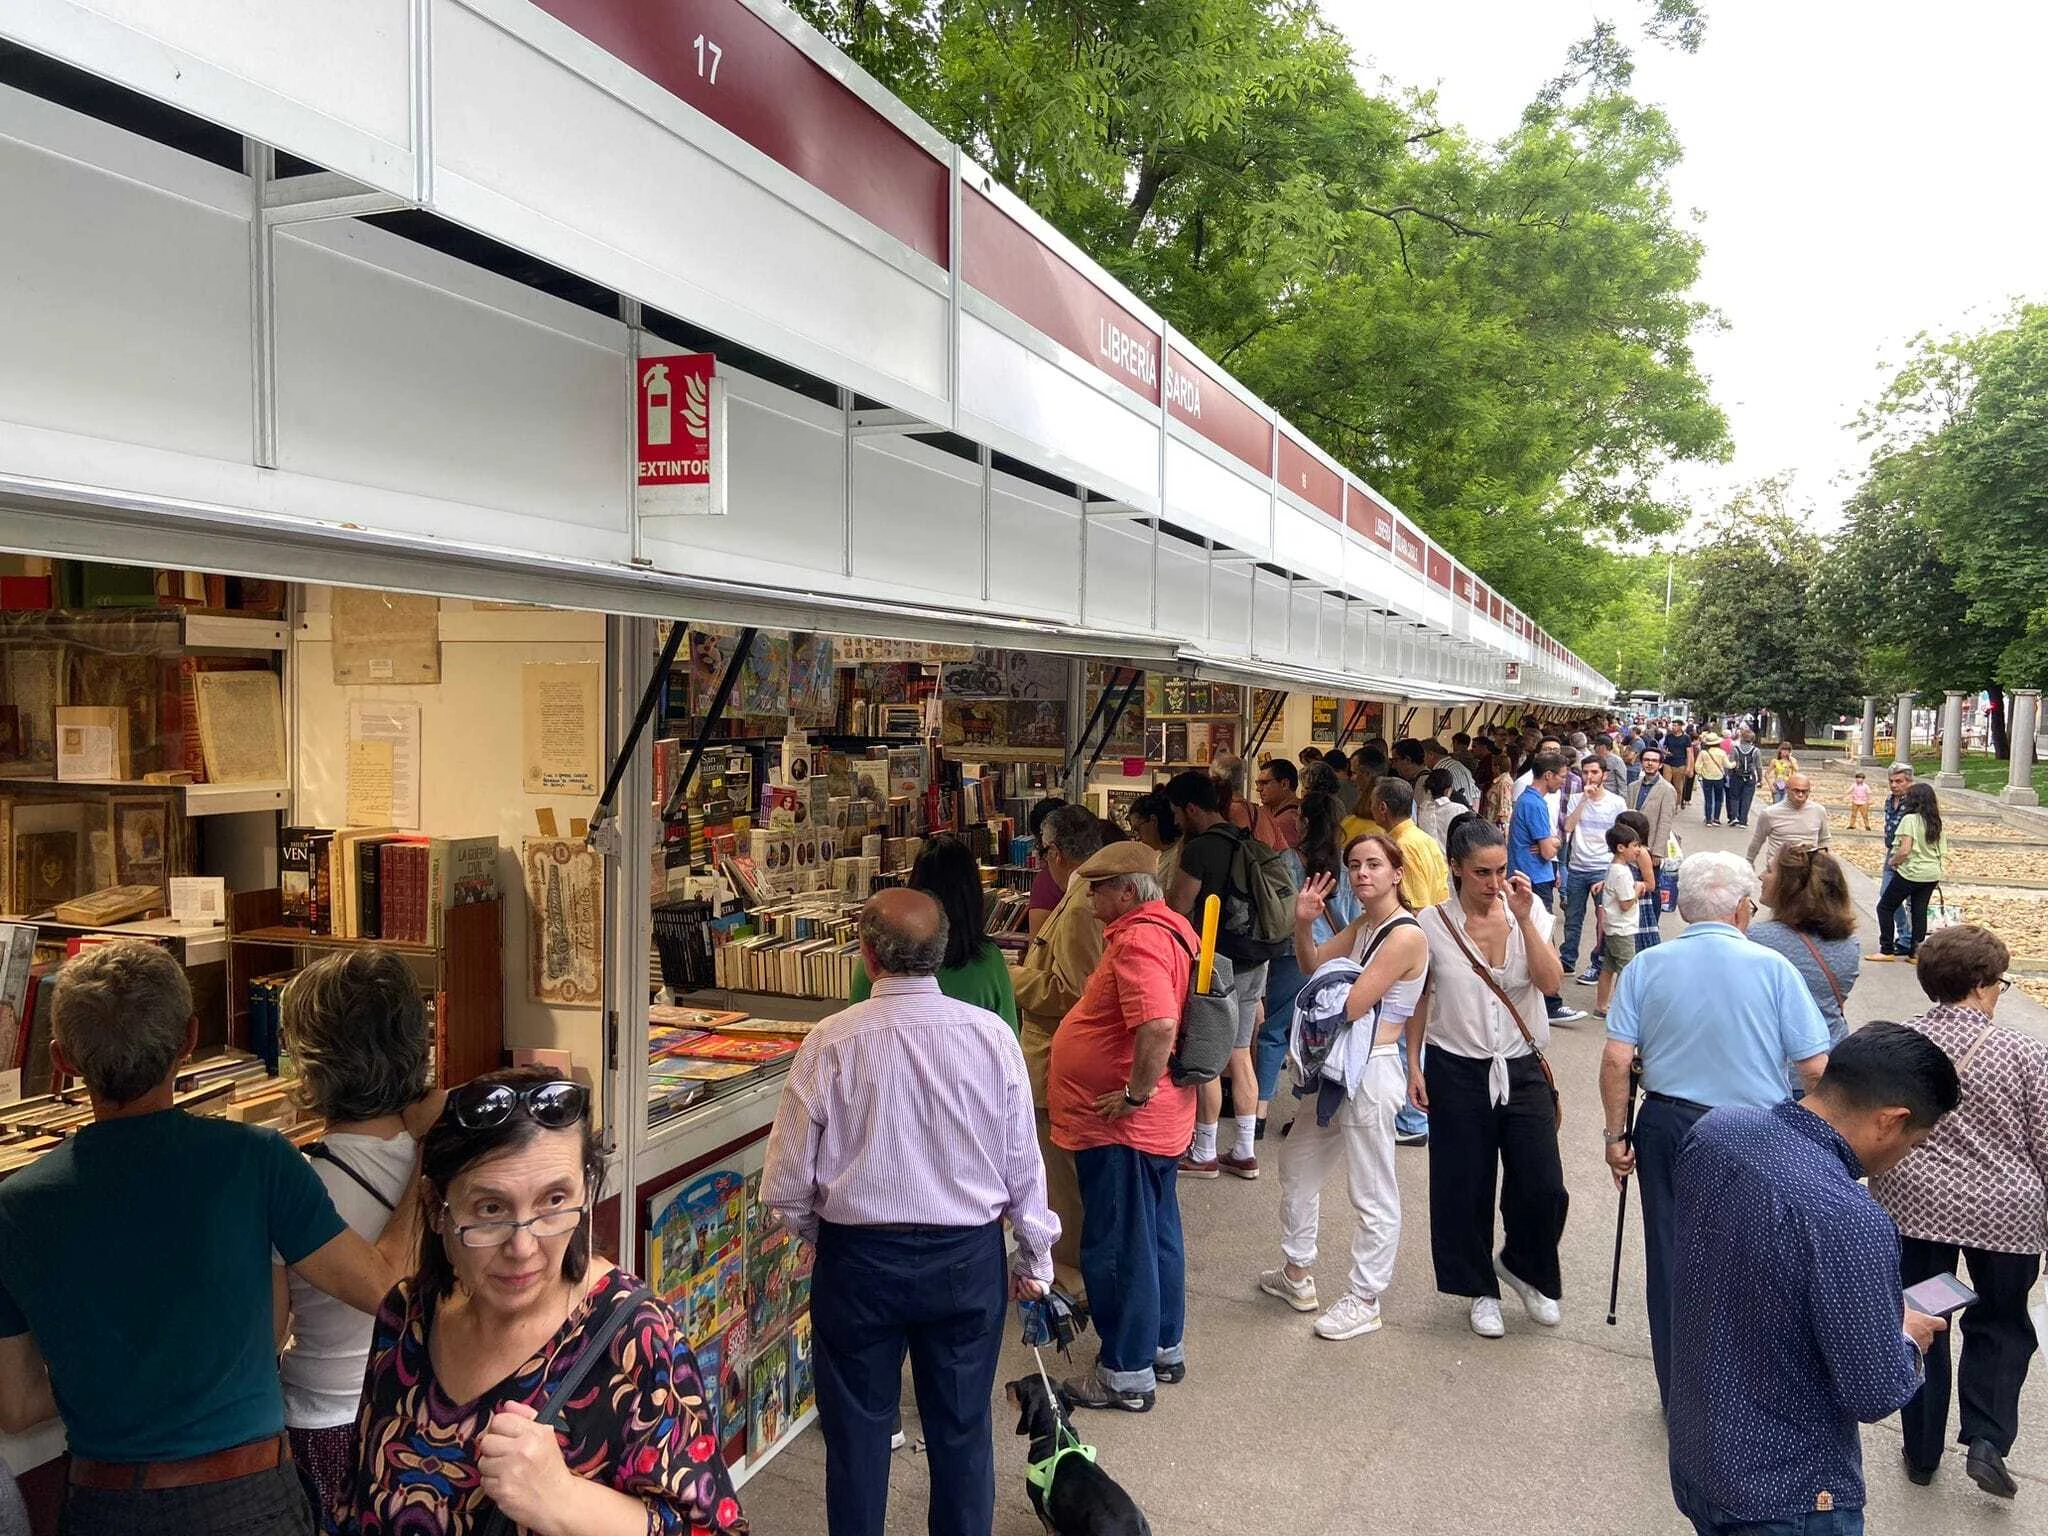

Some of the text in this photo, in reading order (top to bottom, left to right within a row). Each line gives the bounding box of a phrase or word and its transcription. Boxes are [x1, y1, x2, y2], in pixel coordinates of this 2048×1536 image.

[693, 33, 722, 85] 17
[1100, 317, 1157, 390] LIBRERÍA
[639, 460, 710, 477] EXTINTOR
